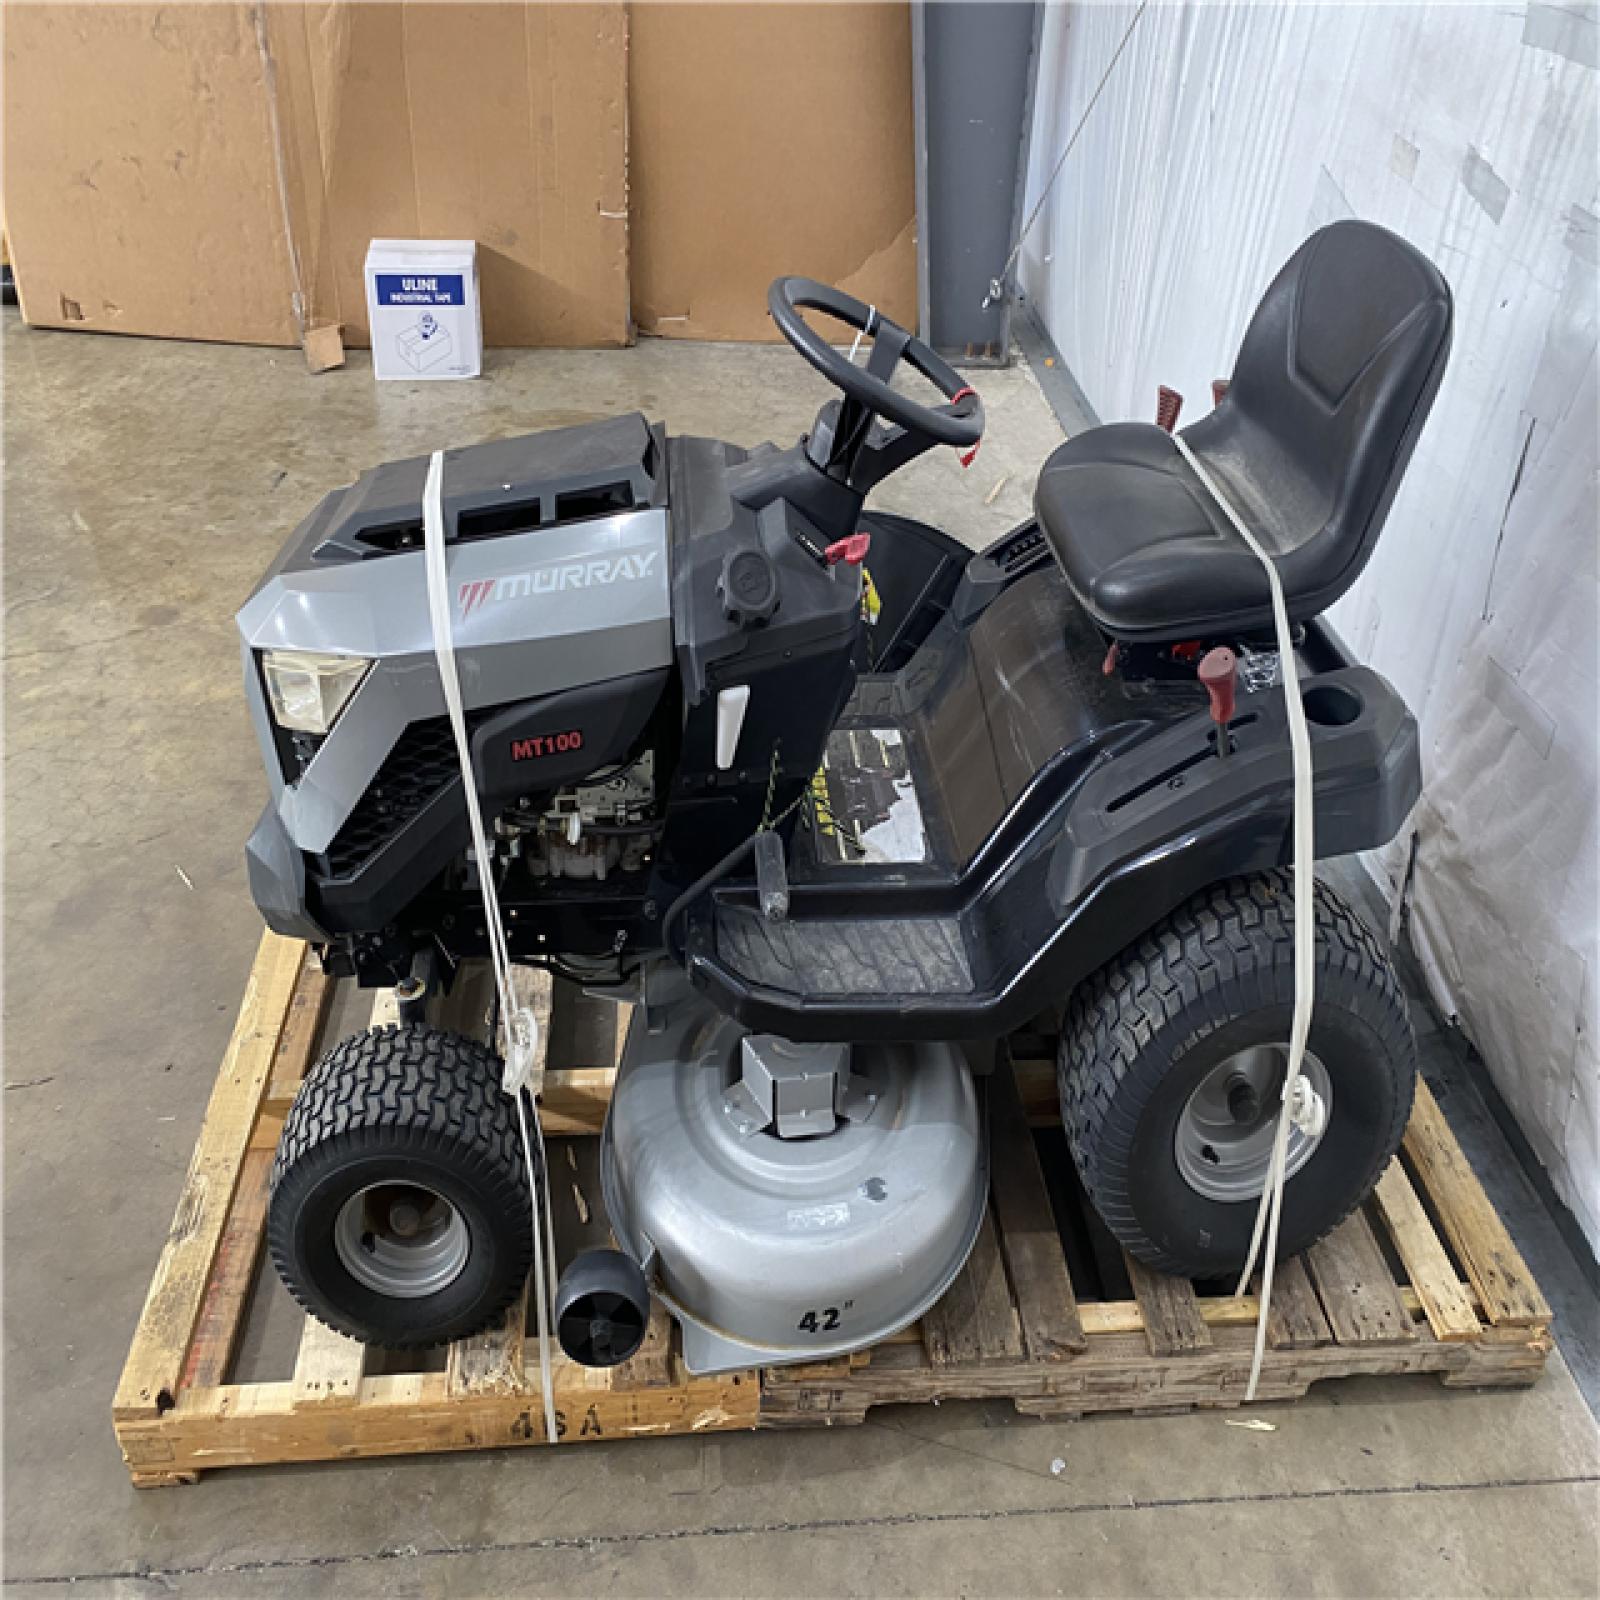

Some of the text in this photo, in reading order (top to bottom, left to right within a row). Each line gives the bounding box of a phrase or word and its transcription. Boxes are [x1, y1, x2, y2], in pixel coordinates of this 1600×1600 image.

[402, 277, 438, 291] ULINE
[495, 551, 658, 601] MURRAY
[511, 730, 583, 761] MT100
